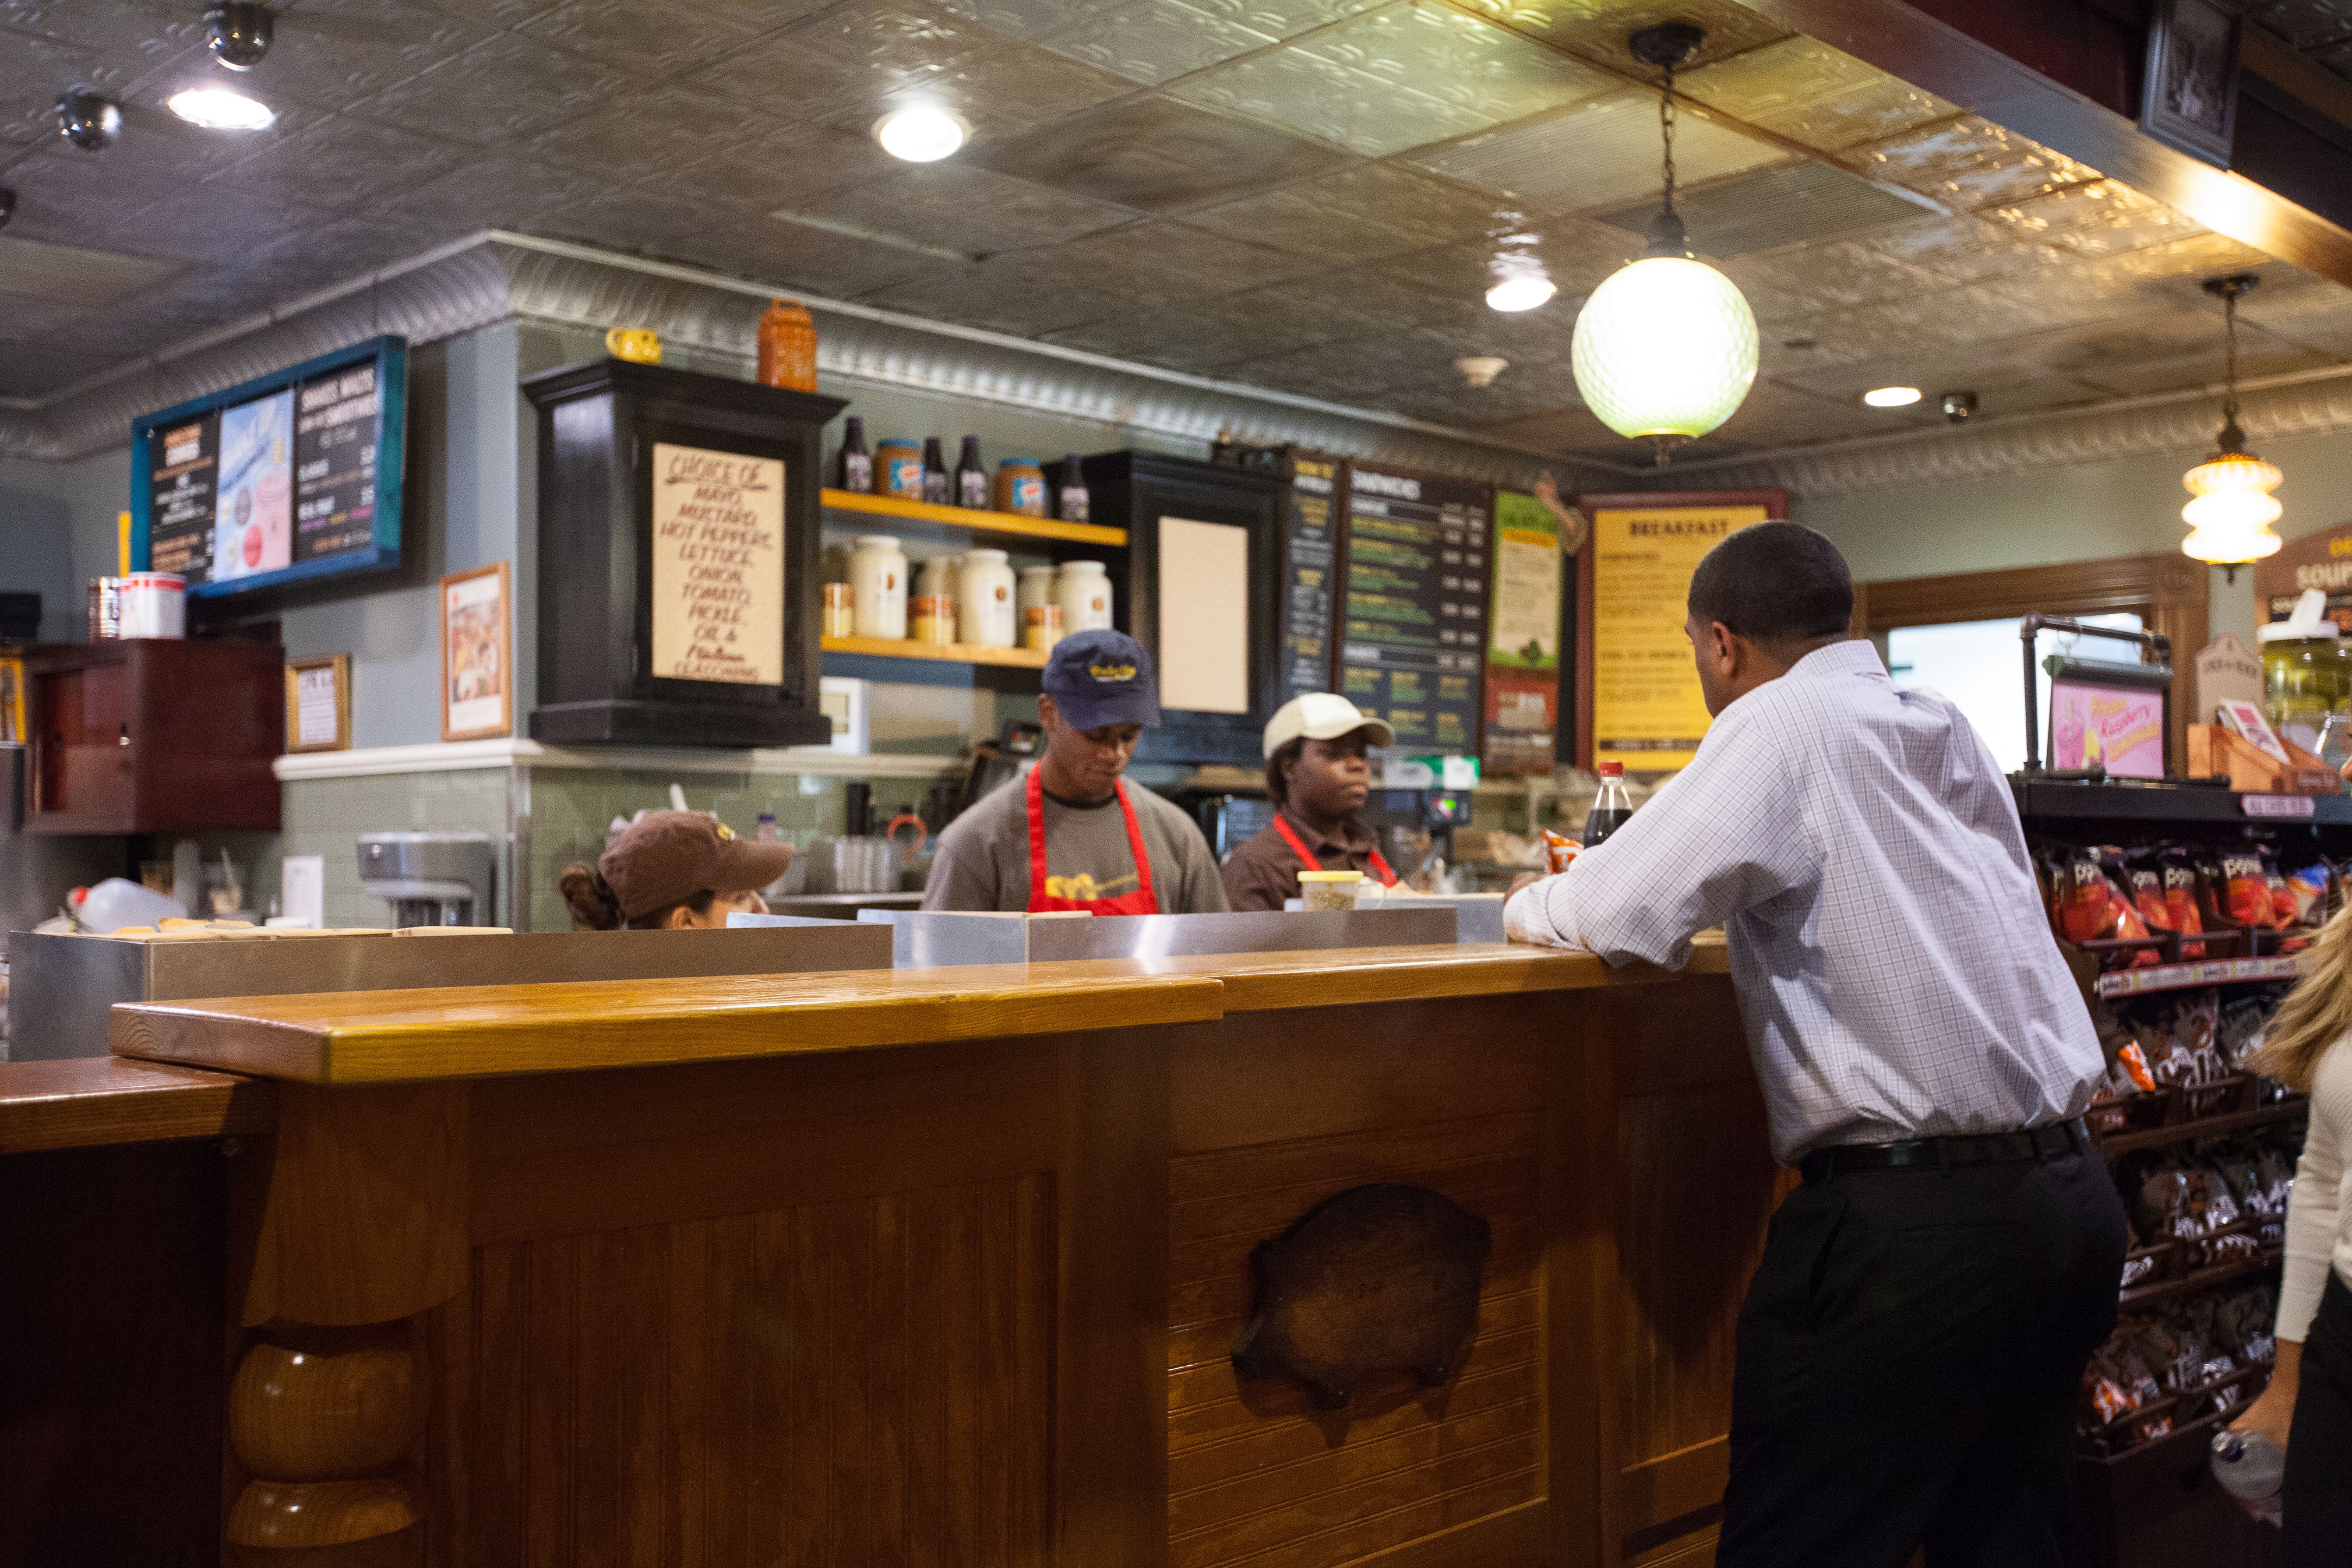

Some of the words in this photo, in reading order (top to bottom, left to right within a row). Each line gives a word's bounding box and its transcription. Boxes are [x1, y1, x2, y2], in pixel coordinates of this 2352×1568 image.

[669, 454, 733, 484] CHOICE
[738, 462, 762, 483] OF
[1630, 518, 1729, 537] BREAKFAST
